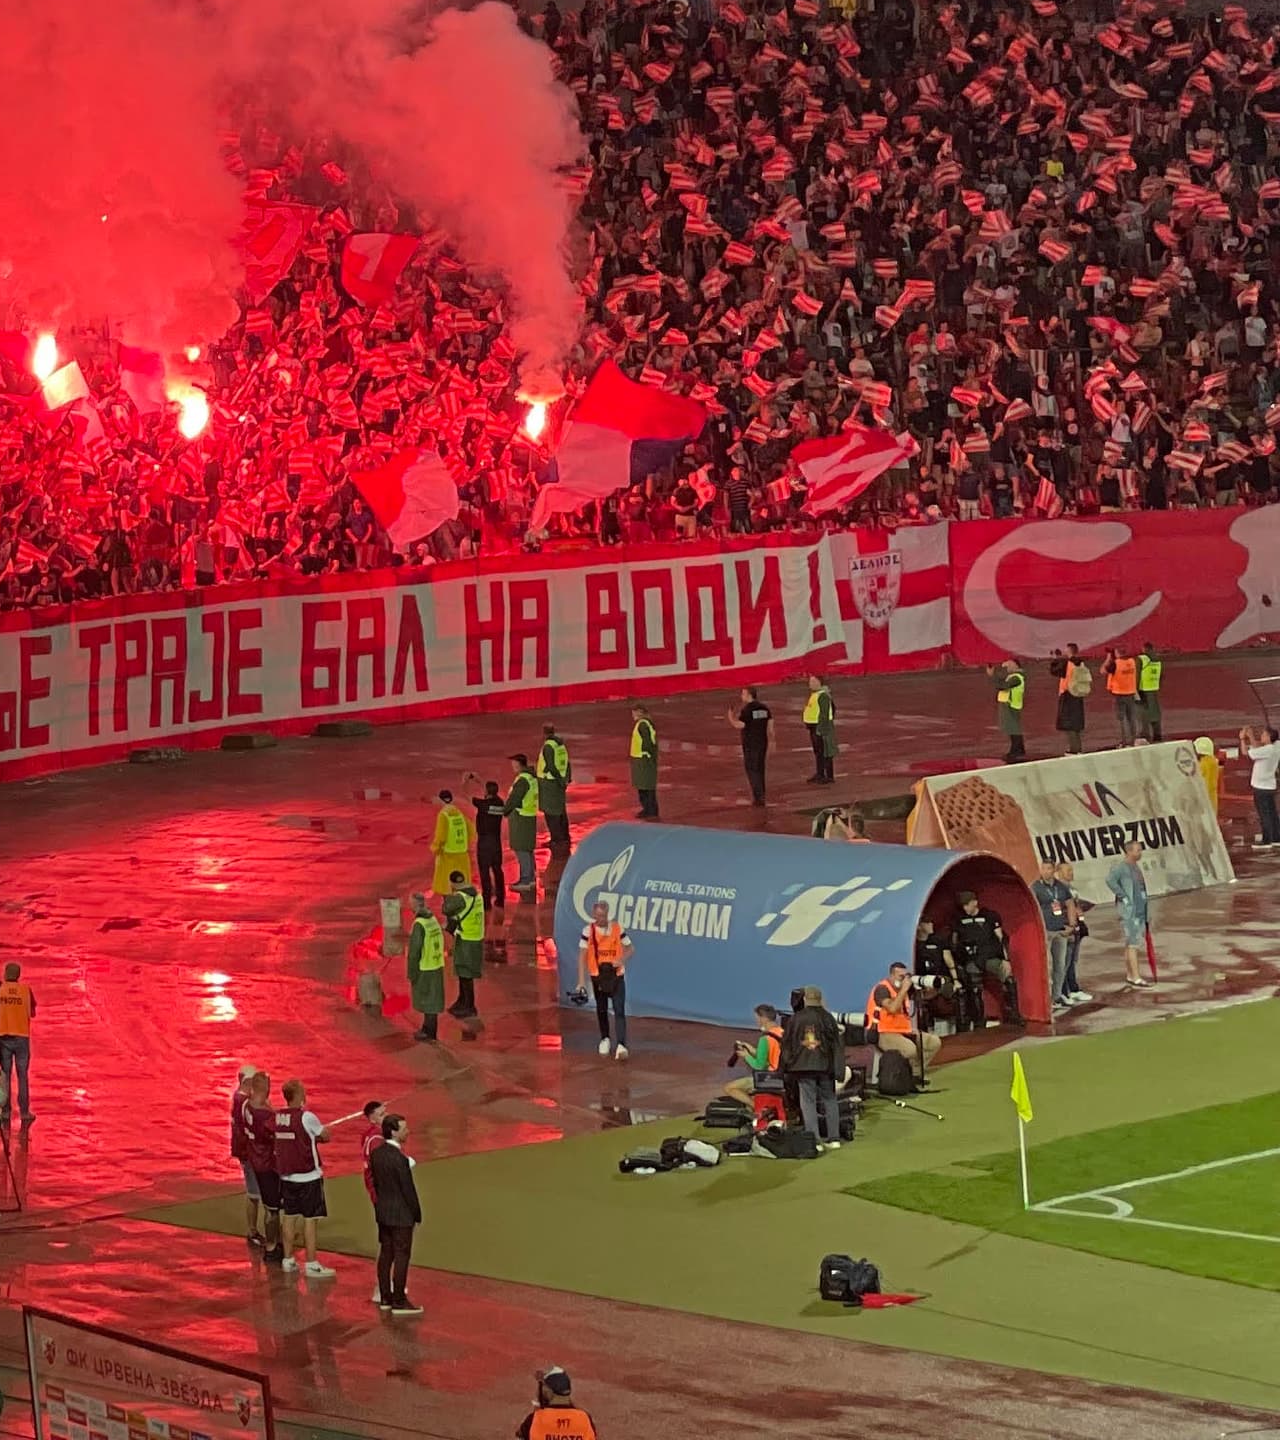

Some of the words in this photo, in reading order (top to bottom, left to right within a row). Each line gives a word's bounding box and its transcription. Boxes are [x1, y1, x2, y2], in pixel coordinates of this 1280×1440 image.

[79, 608, 263, 736] ТРАЈЕ
[301, 594, 429, 708] БАЛ
[464, 579, 549, 686] НА
[585, 550, 827, 672] ВОДИ!
[1035, 815, 1184, 864] UNIVERZUM
[645, 879, 684, 895] PETROL
[686, 883, 737, 900] STATIONS
[617, 894, 733, 940] GAZPROM
[66, 1348, 88, 1369] ФК
[94, 1356, 157, 1393] ЦРВЕНА
[160, 1376, 225, 1413] ЗВЕЗДА
